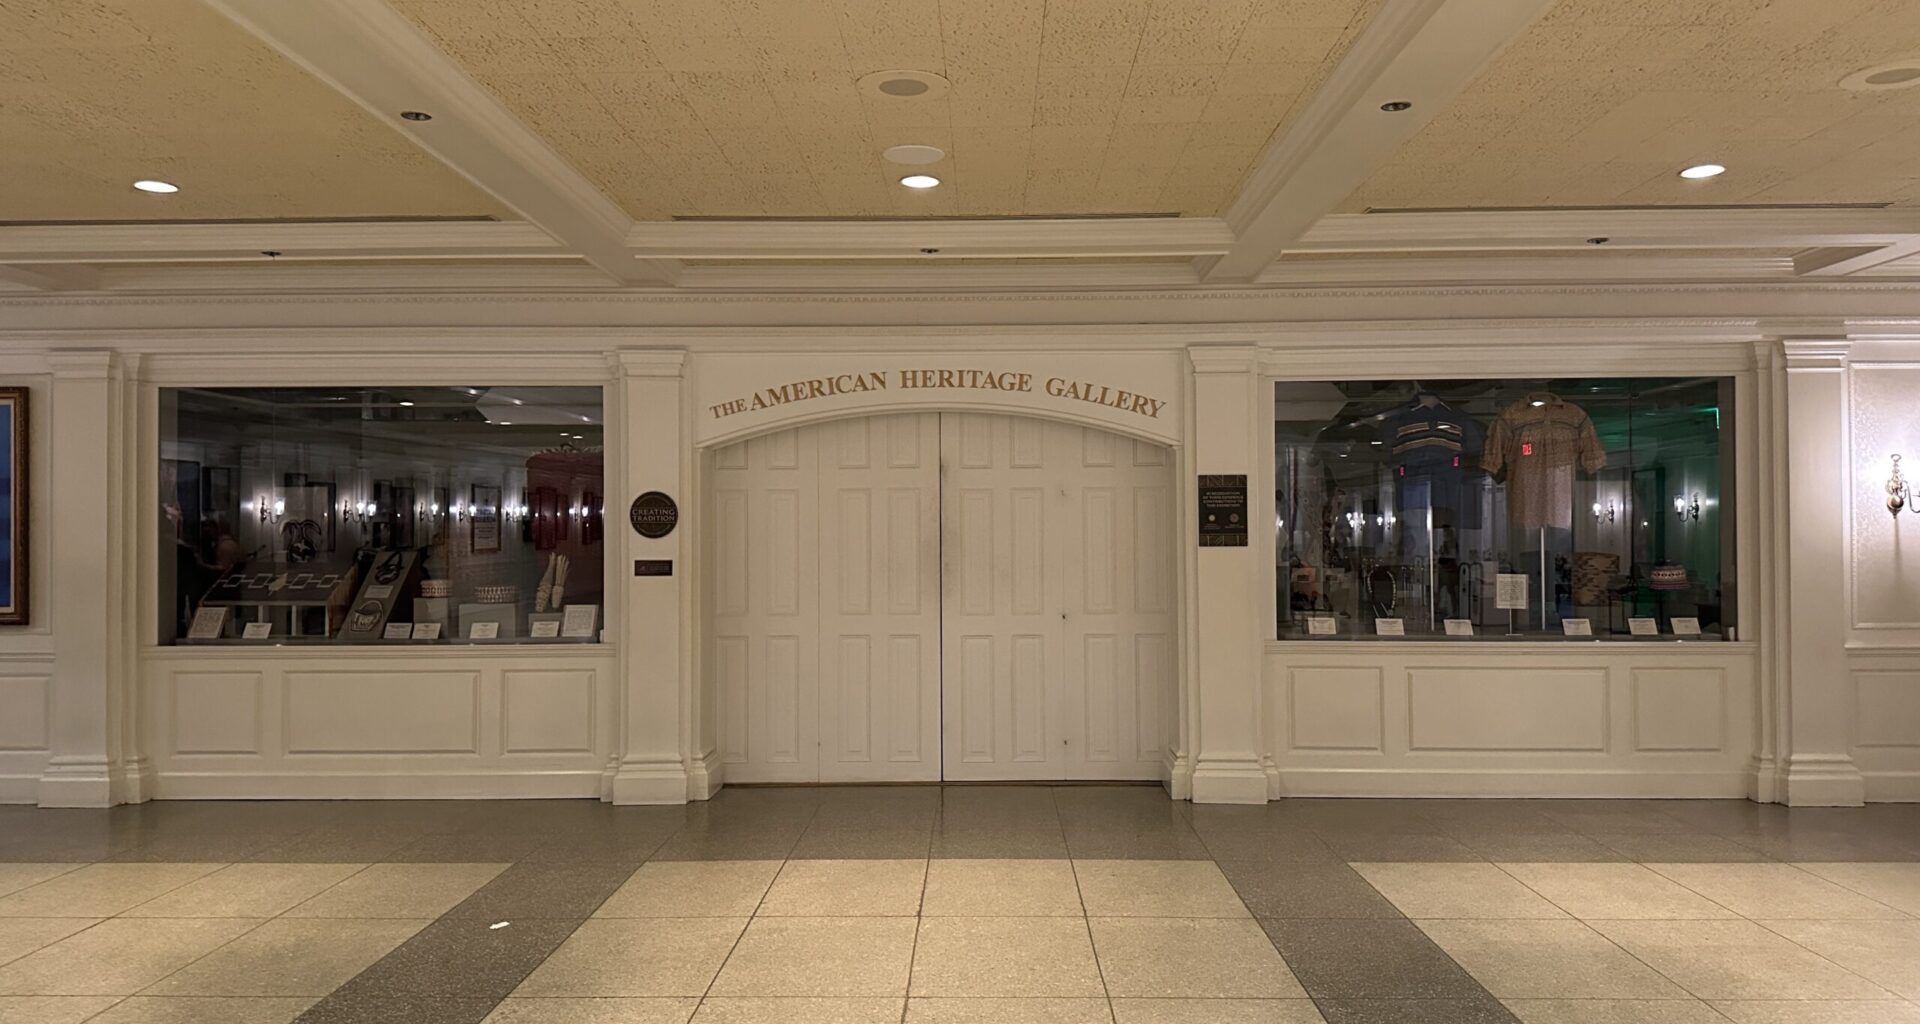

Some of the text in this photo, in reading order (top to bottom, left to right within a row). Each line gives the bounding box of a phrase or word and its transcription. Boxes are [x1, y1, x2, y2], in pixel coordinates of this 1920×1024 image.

[709, 370, 1167, 419] THE AMERICAN HERITAGE GALLERY
